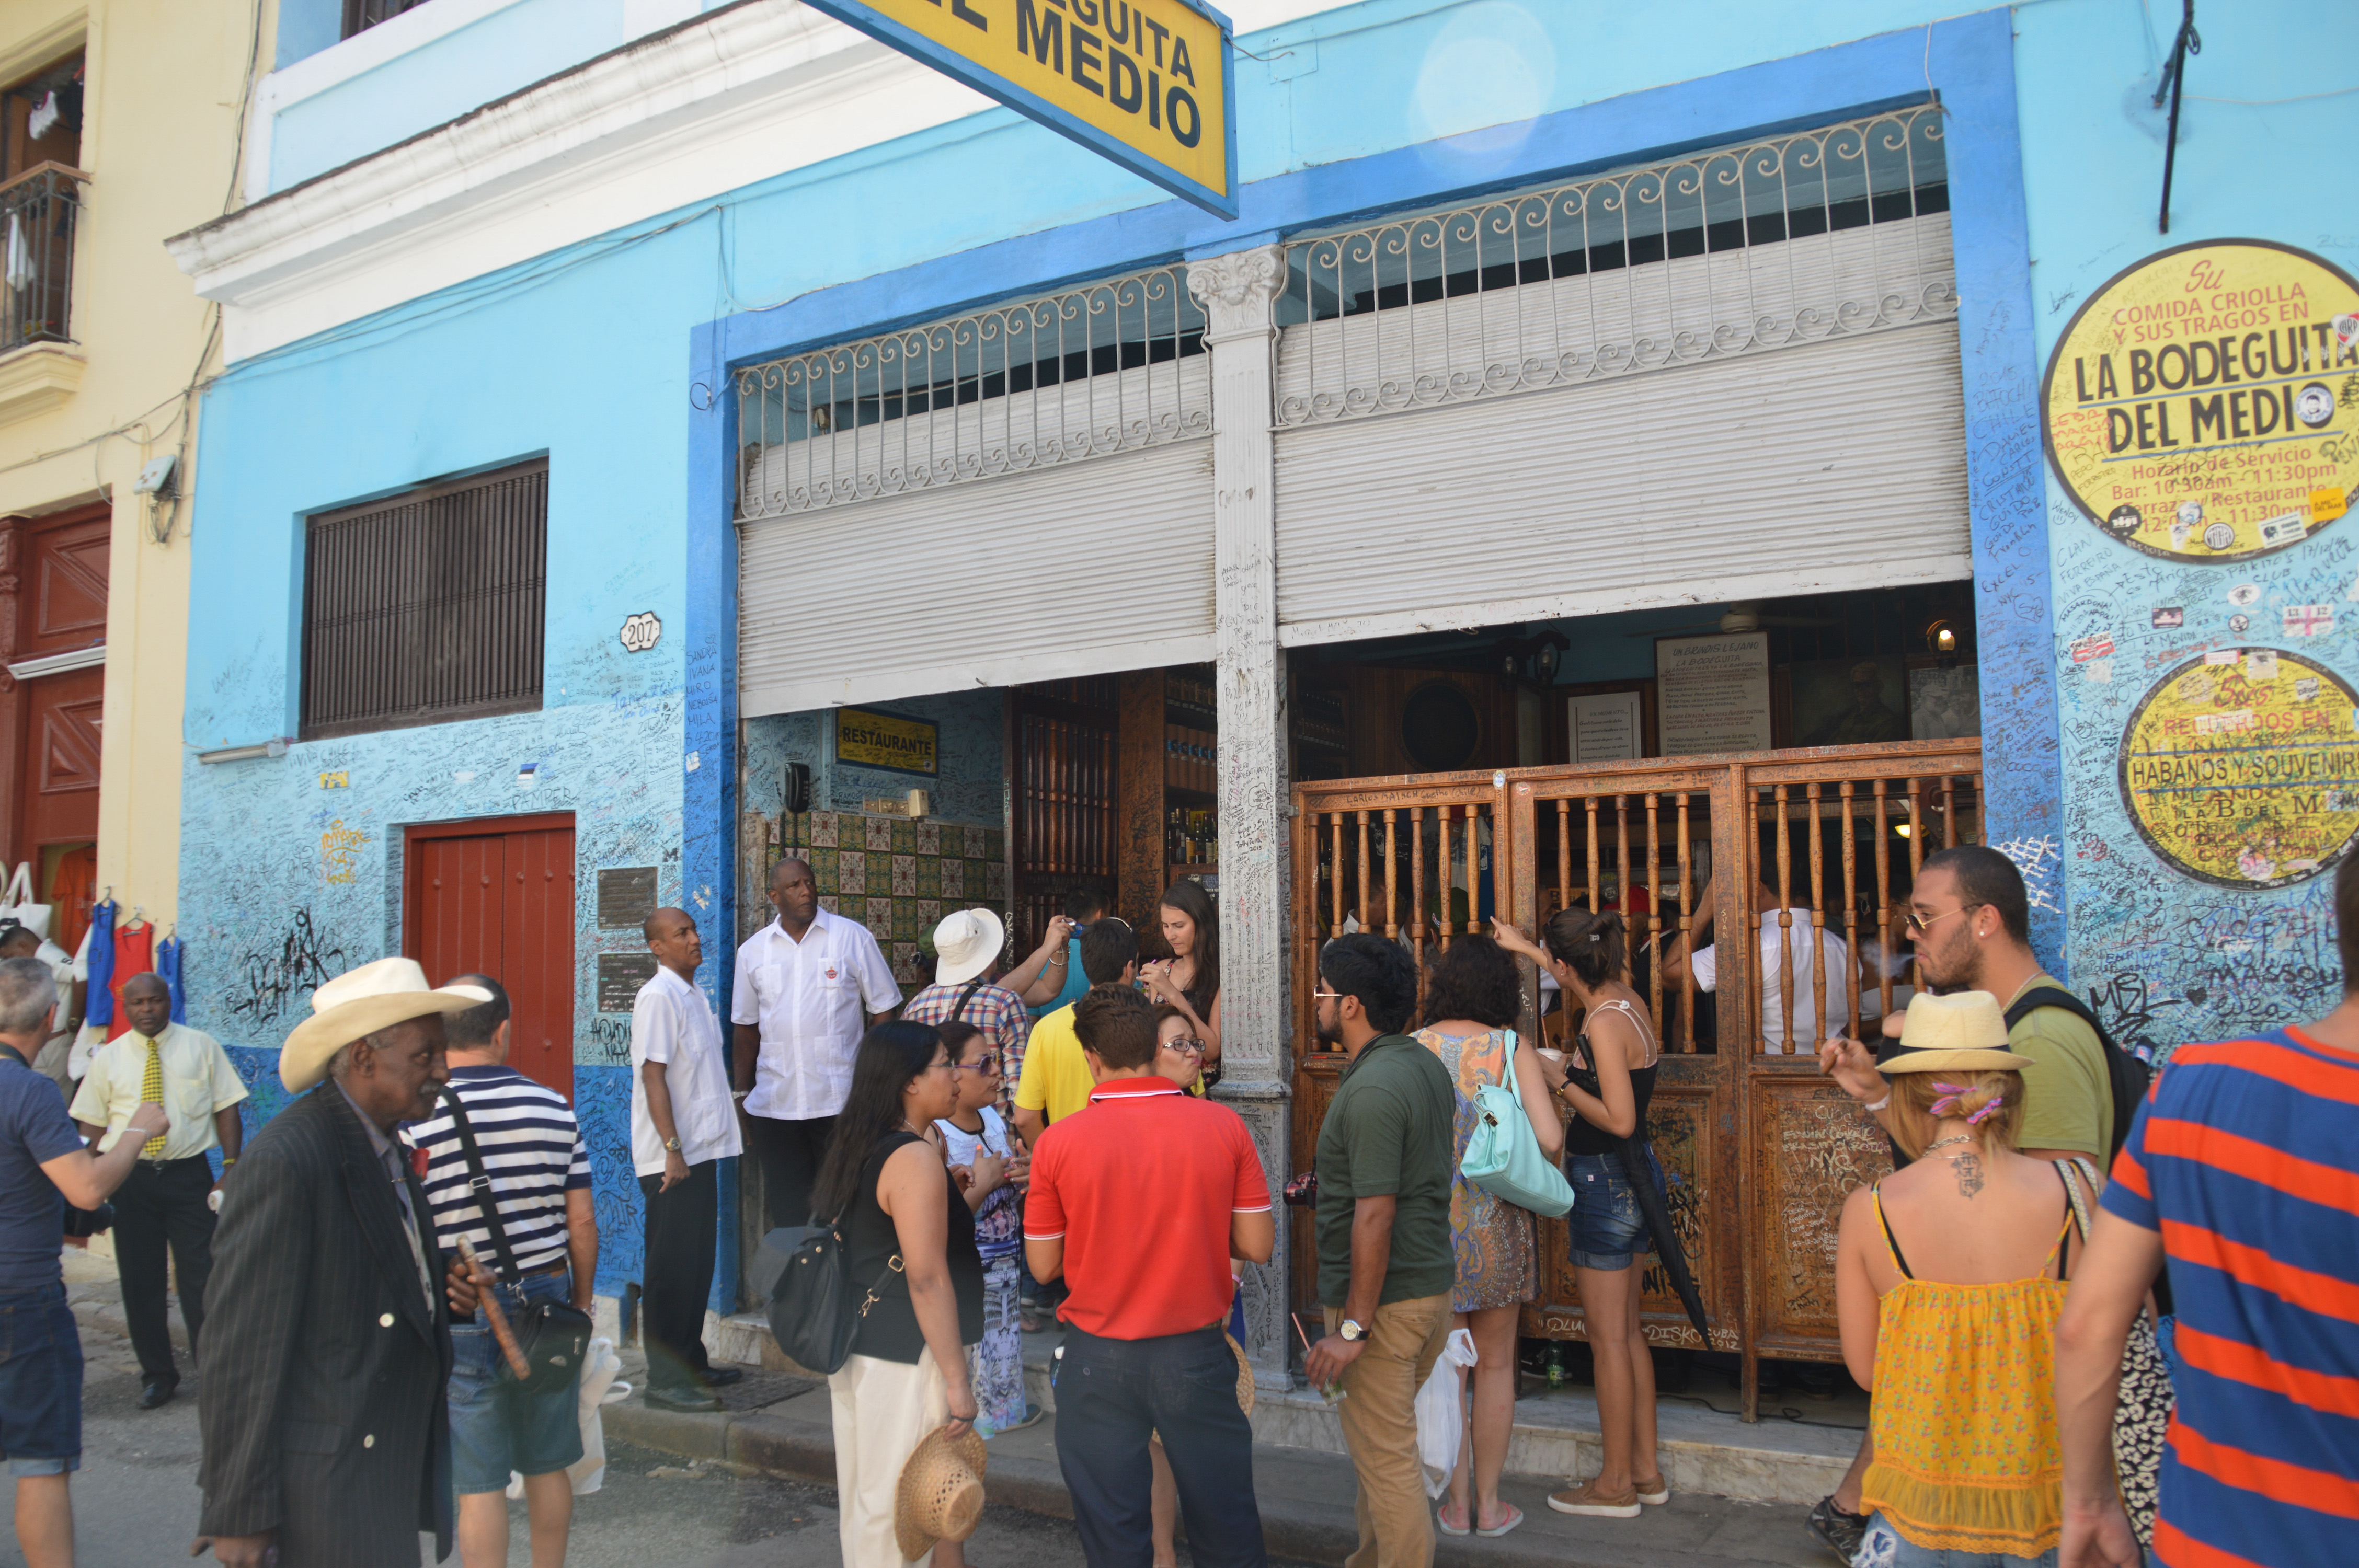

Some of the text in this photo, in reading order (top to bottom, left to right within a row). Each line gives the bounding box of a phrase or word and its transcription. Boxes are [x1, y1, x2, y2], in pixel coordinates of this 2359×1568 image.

[1045, 0, 1196, 88] GUITA
[1016, 0, 1201, 148] MEDIO
[2185, 259, 2225, 293] Su
[2114, 282, 2307, 326] COMIDA CRIOLLA
[2113, 301, 2309, 345] Y SUS TRAGOS EN
[2075, 354, 2119, 402] LA
[2106, 400, 2179, 454] DEL
[2132, 446, 2312, 480] Horario de Servicio
[2112, 463, 2337, 500] Bar: 10:30am 11:30pm
[2211, 482, 2327, 508] Restaurante
[2287, 606, 2328, 617] 13 12
[628, 620, 653, 645] 207
[1684, 644, 1721, 655] BRINDIS
[1722, 641, 1759, 652] LEJANO
[1688, 654, 1740, 665] BODEGUITA
[688, 712, 715, 727] MILA
[2301, 709, 2330, 728] EN
[842, 727, 932, 756] RESTAURANTE
[2133, 751, 2359, 785] HABANOS Y SOUVENIR
